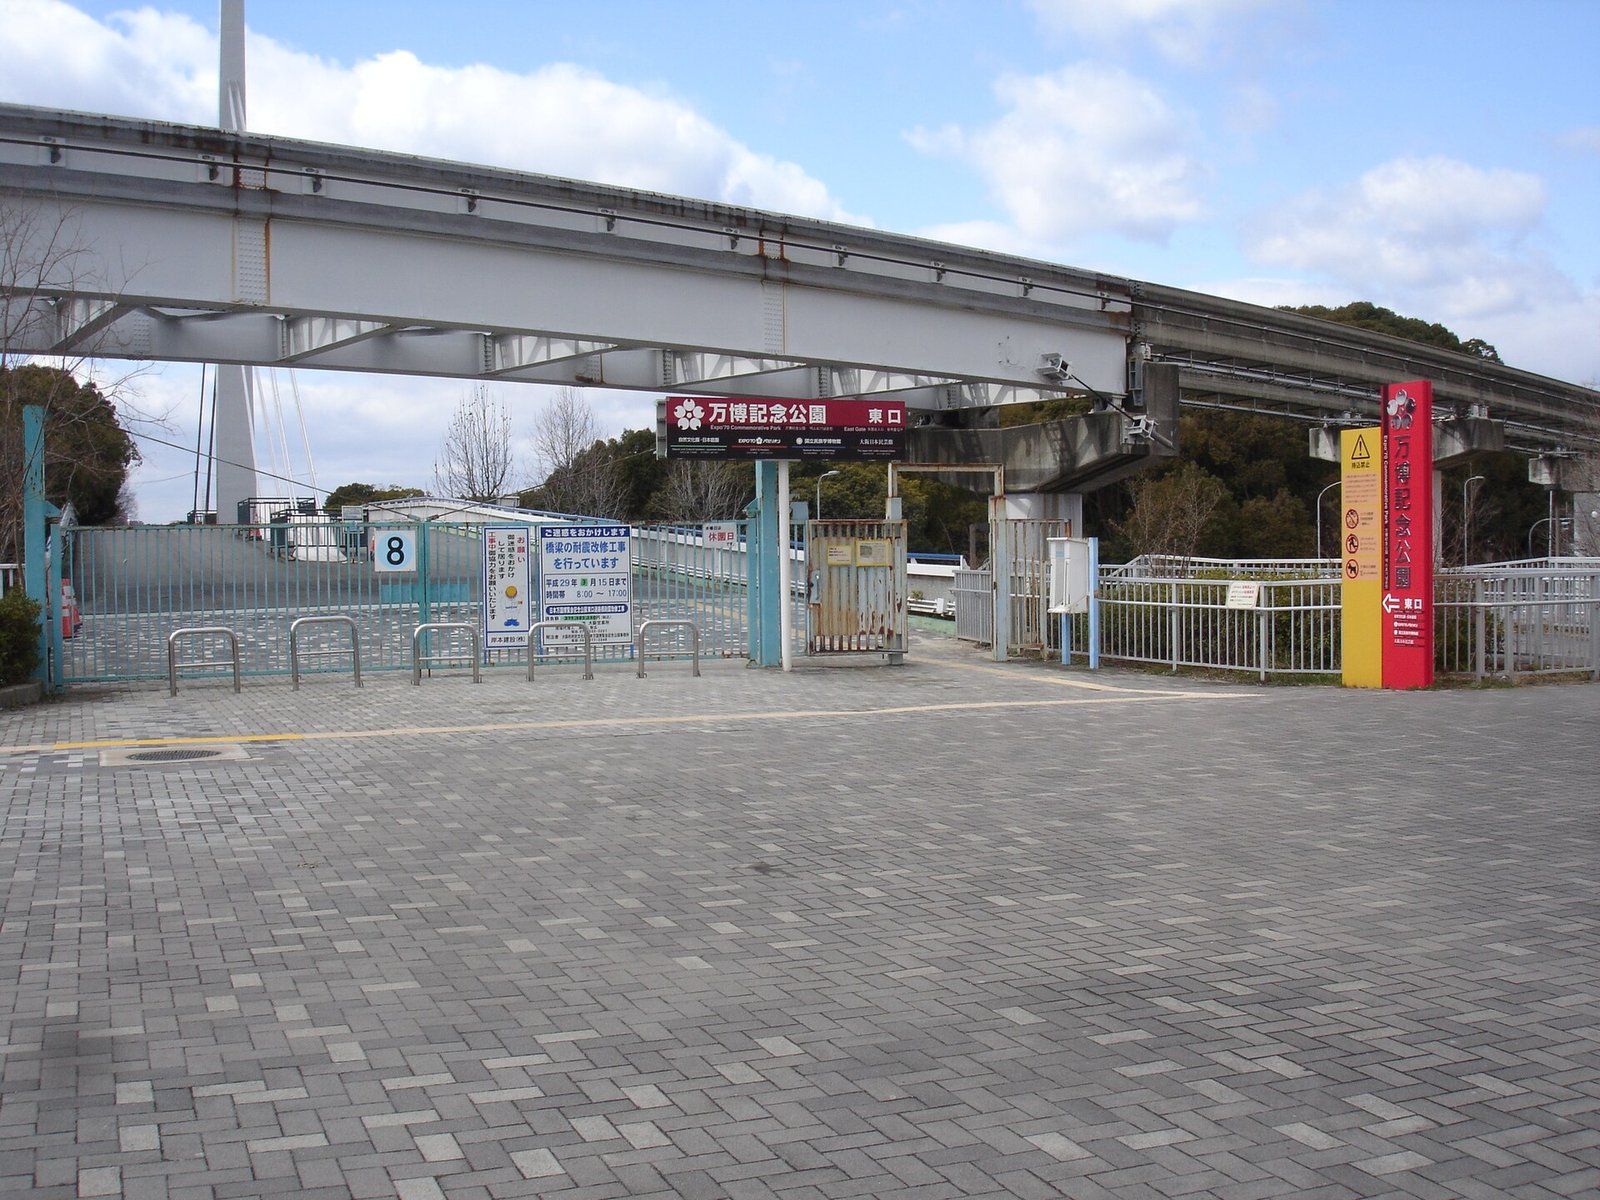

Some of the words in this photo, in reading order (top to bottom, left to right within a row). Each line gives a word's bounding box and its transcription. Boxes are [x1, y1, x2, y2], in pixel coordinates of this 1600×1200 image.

[709, 403, 826, 424] 万博記念公園
[868, 408, 901, 424] 東口
[1393, 434, 1412, 590] 万博記念公園
[545, 528, 626, 536] ご迷惑をおかけします
[387, 536, 404, 565] 8
[516, 536, 526, 562] お願い
[546, 541, 626, 554] 橋梁の耐震改修工事
[554, 557, 619, 570] を行っています
[546, 590, 566, 599] 時間帯
[1404, 598, 1422, 610] 東口
